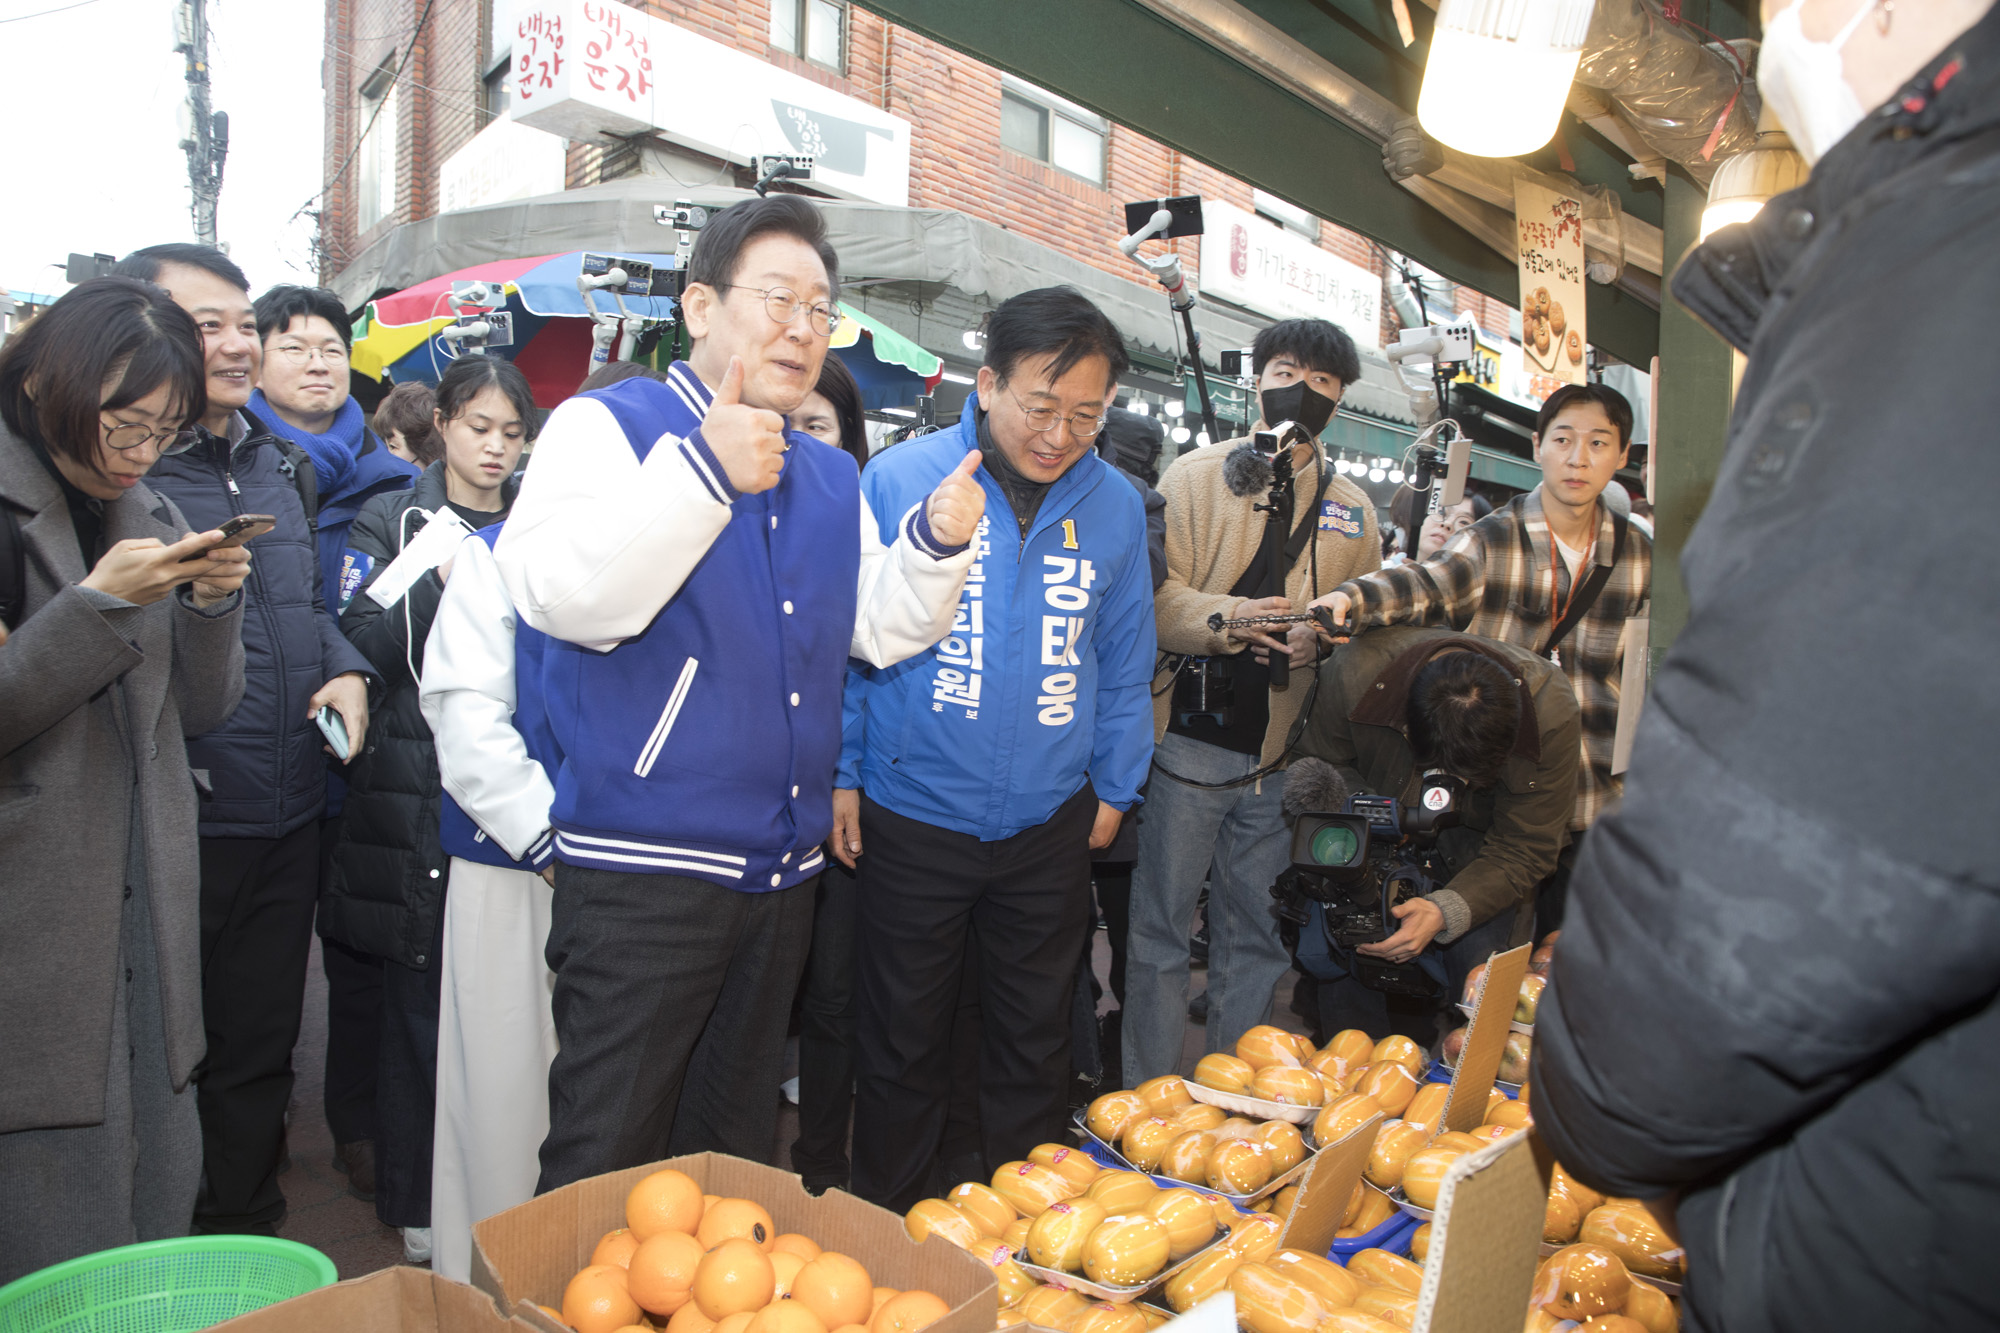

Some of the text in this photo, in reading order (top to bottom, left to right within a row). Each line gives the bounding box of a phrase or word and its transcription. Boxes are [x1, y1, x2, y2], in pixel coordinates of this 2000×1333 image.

[518, 11, 564, 56] 백정
[583, 1, 652, 72] 백정
[1519, 218, 1556, 250] 상주곶감
[1521, 248, 1580, 284] 냉동고에 있어요
[1061, 518, 1080, 551] 1
[1318, 515, 1360, 534] PRESS
[1037, 554, 1096, 727] 강태웅
